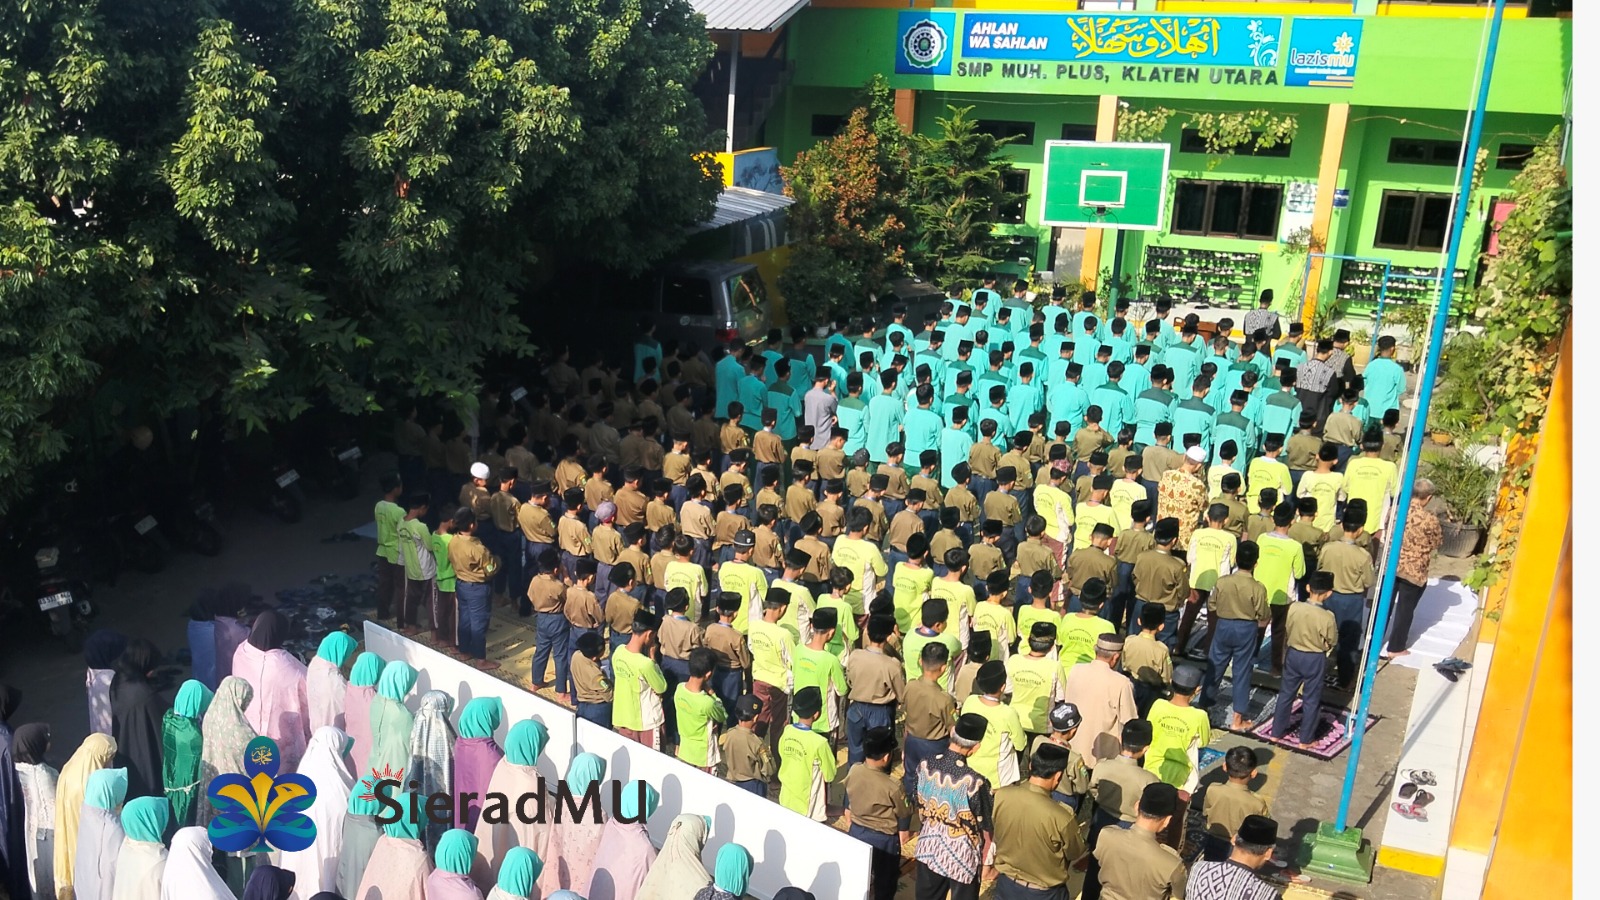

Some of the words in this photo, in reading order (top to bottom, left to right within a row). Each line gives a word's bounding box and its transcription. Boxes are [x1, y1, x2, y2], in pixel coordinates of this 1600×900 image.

[970, 22, 1019, 35] AHLAN
[969, 36, 991, 49] WA
[992, 36, 1049, 50] SAHLAN
[1290, 48, 1355, 67] lazismu
[957, 62, 993, 77] SMP
[1002, 63, 1047, 79] MUH.
[1056, 64, 1110, 83] PLUS,
[1122, 65, 1199, 83] KLATEN
[1209, 67, 1278, 85] UTARA
